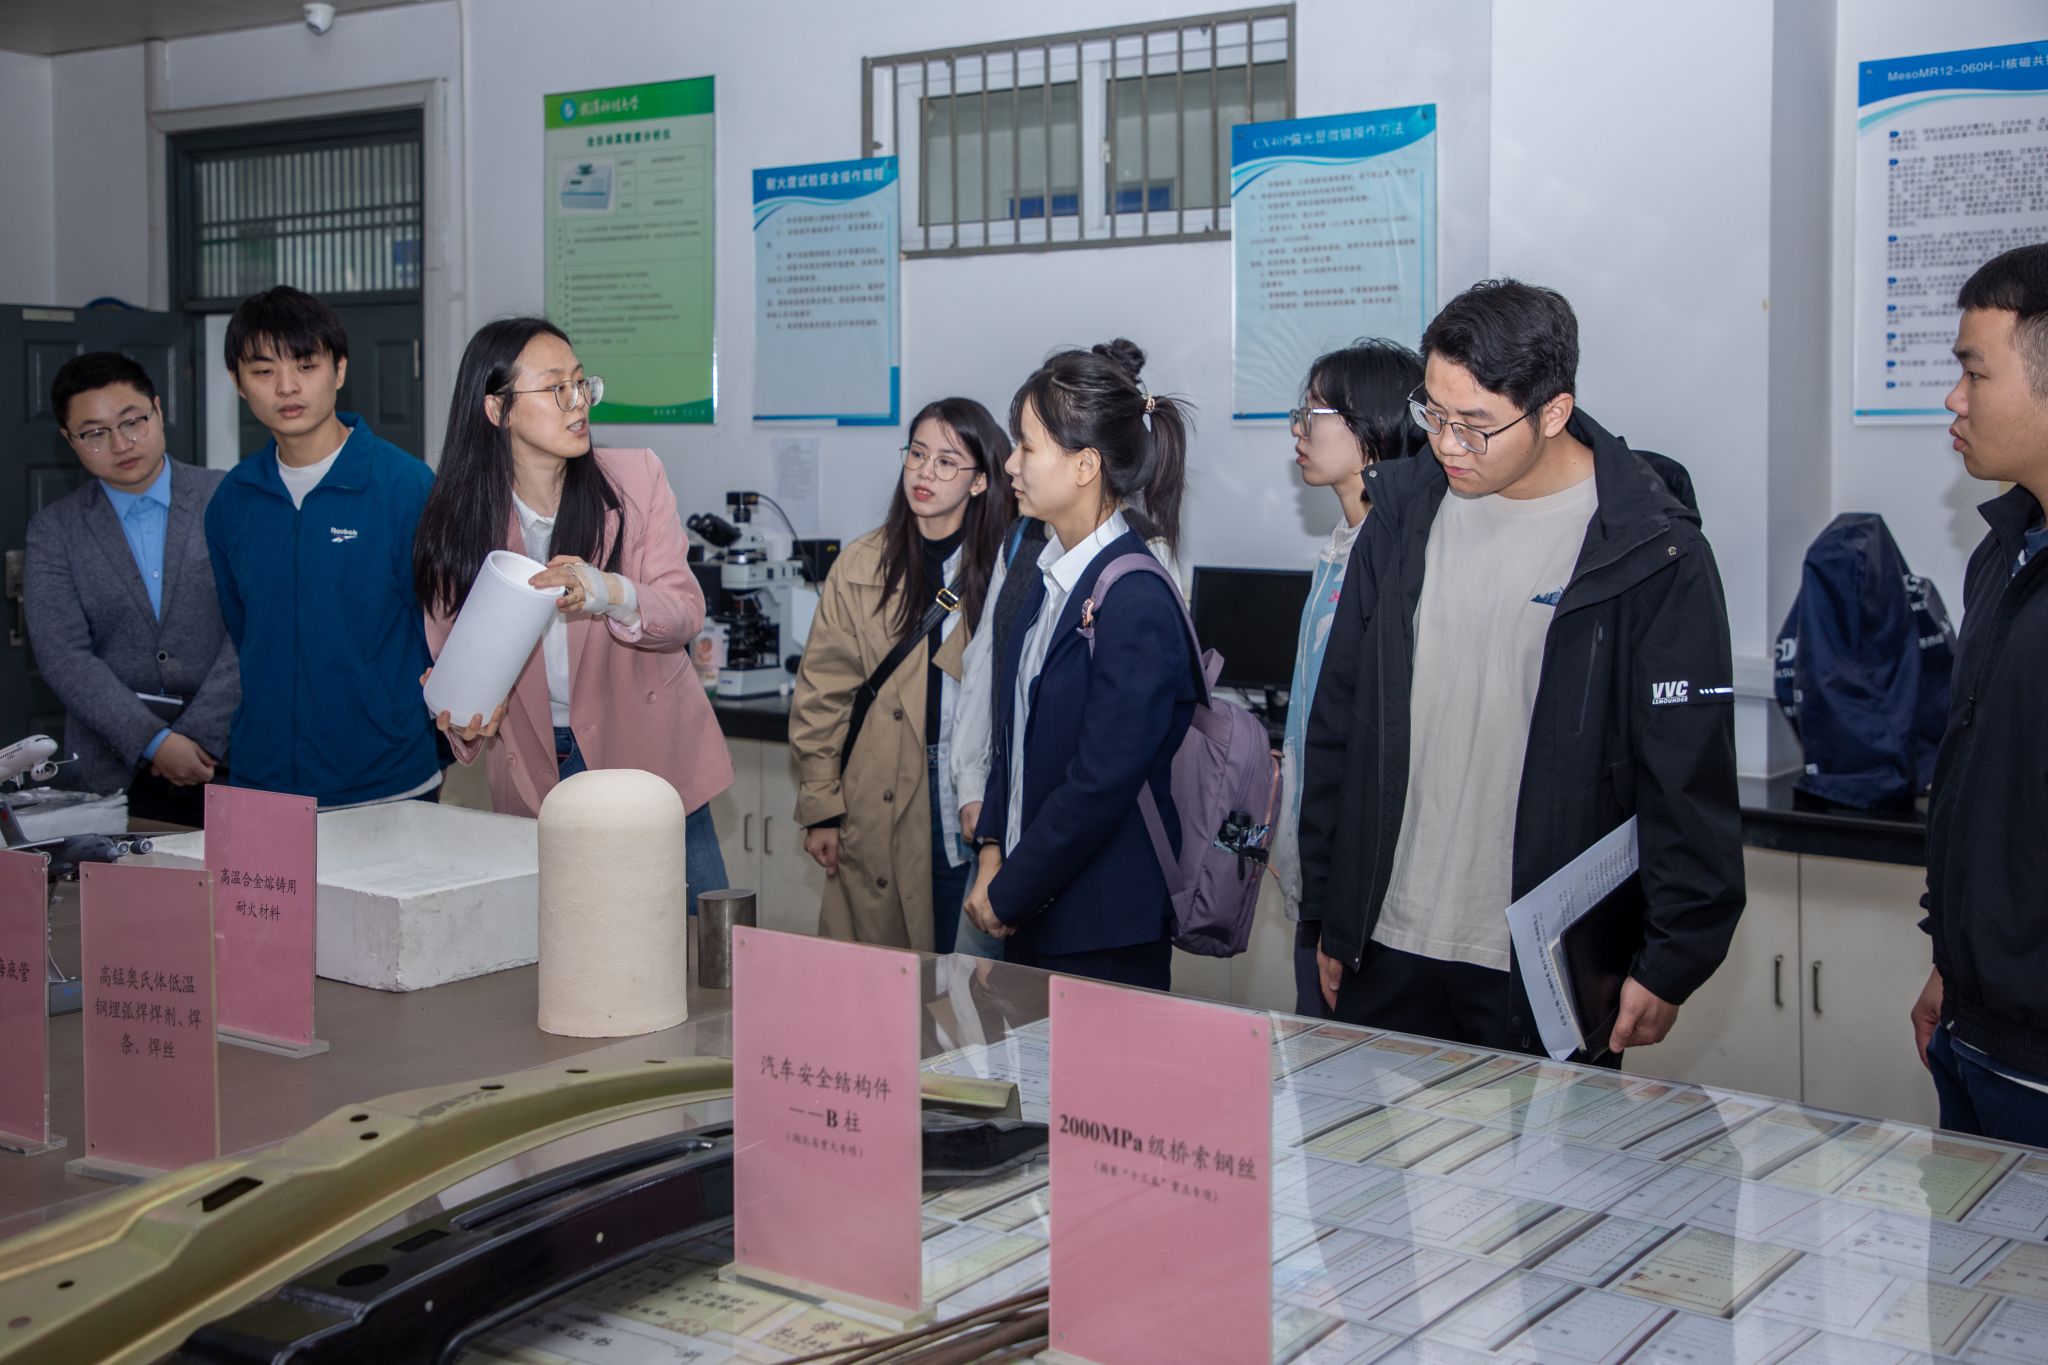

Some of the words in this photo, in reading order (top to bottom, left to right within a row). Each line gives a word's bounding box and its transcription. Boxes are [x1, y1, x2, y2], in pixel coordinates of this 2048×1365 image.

[1888, 55, 2048, 82] MesoMR12-060H-I核磁共
[1652, 680, 1689, 699] VVC
[221, 868, 297, 895] 高温合金熔铸用
[235, 900, 280, 922] 耐火材料
[100, 965, 196, 993] 高锰奥氏体低温
[95, 997, 202, 1030] 钢埋弧焊焊剂、焊
[120, 1032, 175, 1059] 条、焊丝
[760, 1055, 892, 1102] 汽车安全结构件
